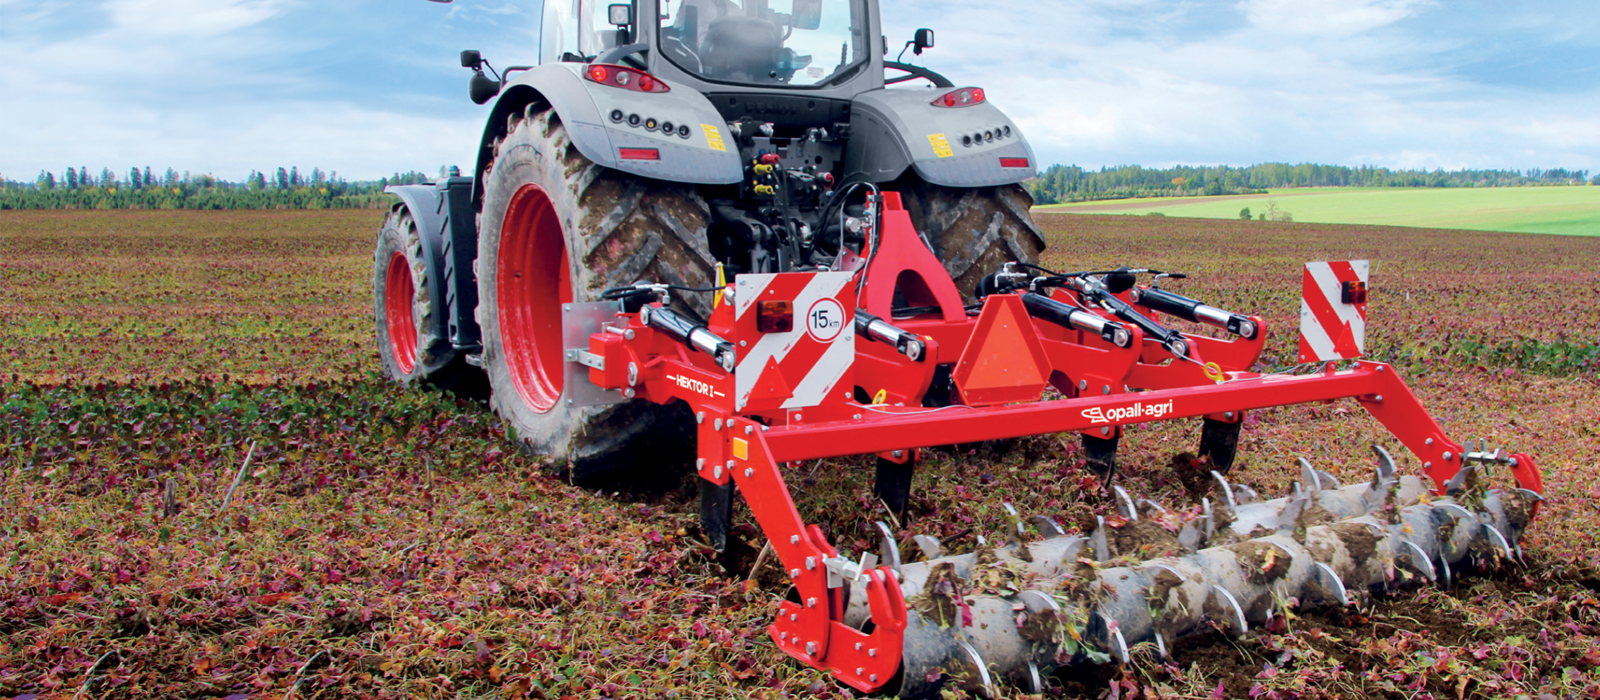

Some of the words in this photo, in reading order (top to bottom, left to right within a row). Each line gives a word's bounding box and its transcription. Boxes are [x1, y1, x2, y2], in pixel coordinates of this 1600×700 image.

[811, 310, 828, 329] 15
[829, 319, 840, 328] km
[676, 374, 709, 396] HEKTOR
